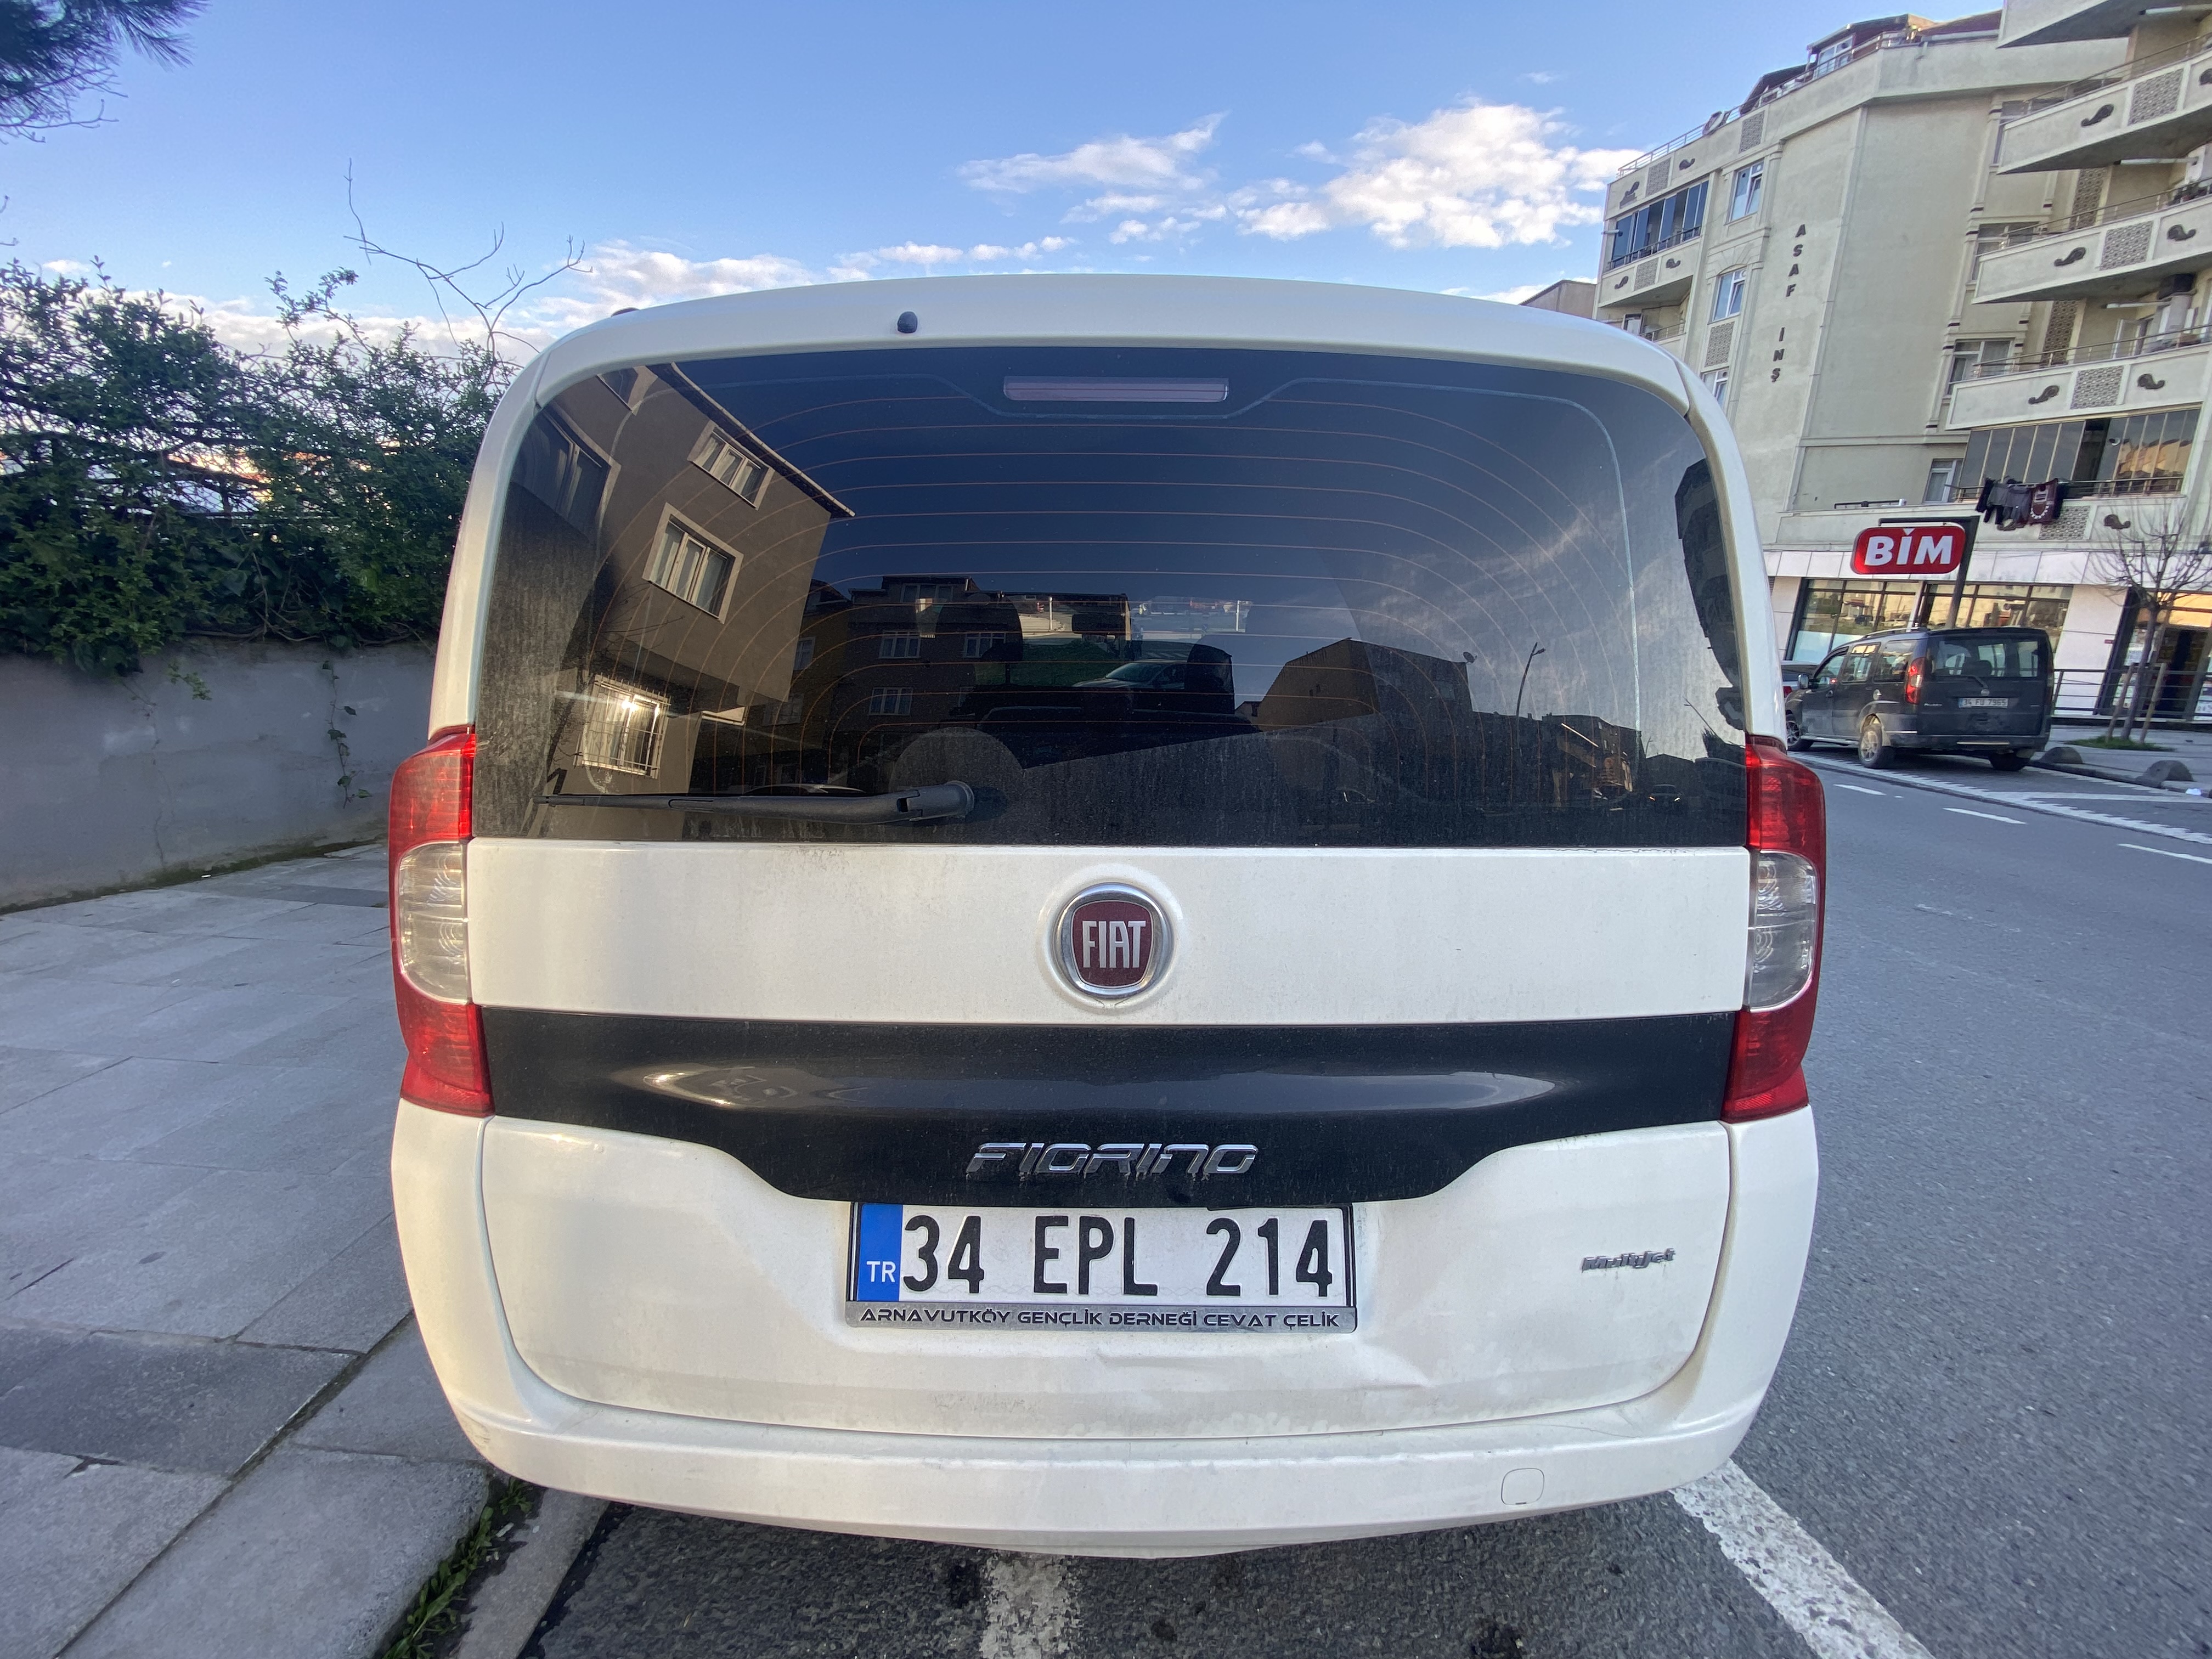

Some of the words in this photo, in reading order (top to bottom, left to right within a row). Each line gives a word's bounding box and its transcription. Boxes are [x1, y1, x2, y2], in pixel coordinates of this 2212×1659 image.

[1786, 223, 1807, 298] ASAF
[1864, 528, 1953, 566] BİM
[1082, 921, 1146, 968] FIAT
[966, 1143, 1258, 1173] FIORINO
[866, 1261, 896, 1283] TR
[903, 1215, 985, 1294] 34
[1034, 1215, 1158, 1296] EPL
[1206, 1218, 1334, 1297] 214
[860, 1308, 1011, 1323] ARNAVUTKÖY
[1017, 1308, 1102, 1328] GENÇLİK
[1109, 1310, 1198, 1327] DERNEĞİ
[1204, 1313, 1277, 1327] CEVAT
[1283, 1311, 1340, 1330] ÇELİK
